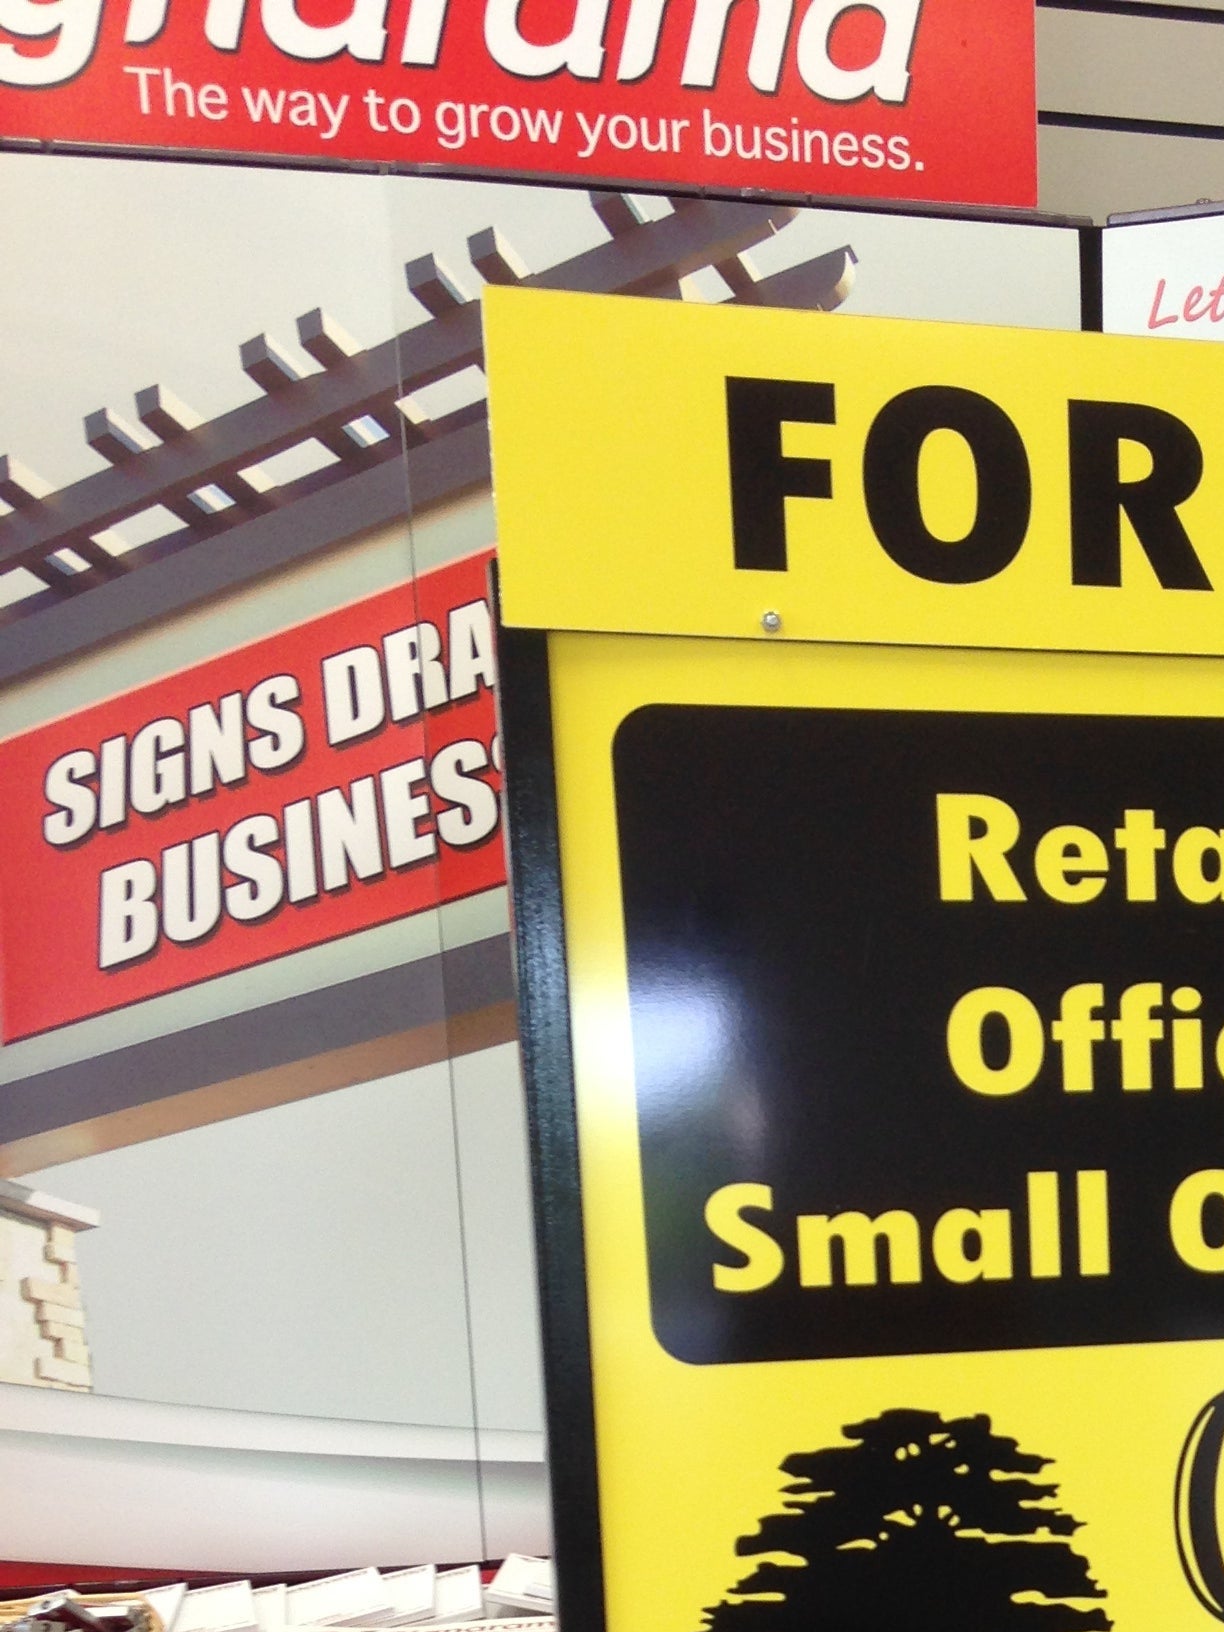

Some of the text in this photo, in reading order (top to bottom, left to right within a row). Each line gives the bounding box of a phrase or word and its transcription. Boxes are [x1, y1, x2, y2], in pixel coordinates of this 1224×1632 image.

[123, 65, 925, 171] The way to grow your business.
[726, 374, 1215, 590] FOR
[321, 599, 495, 747] DRA
[43, 674, 305, 846] SIGNS
[98, 738, 503, 970] BUSINES
[702, 1169, 1110, 1293] Small
